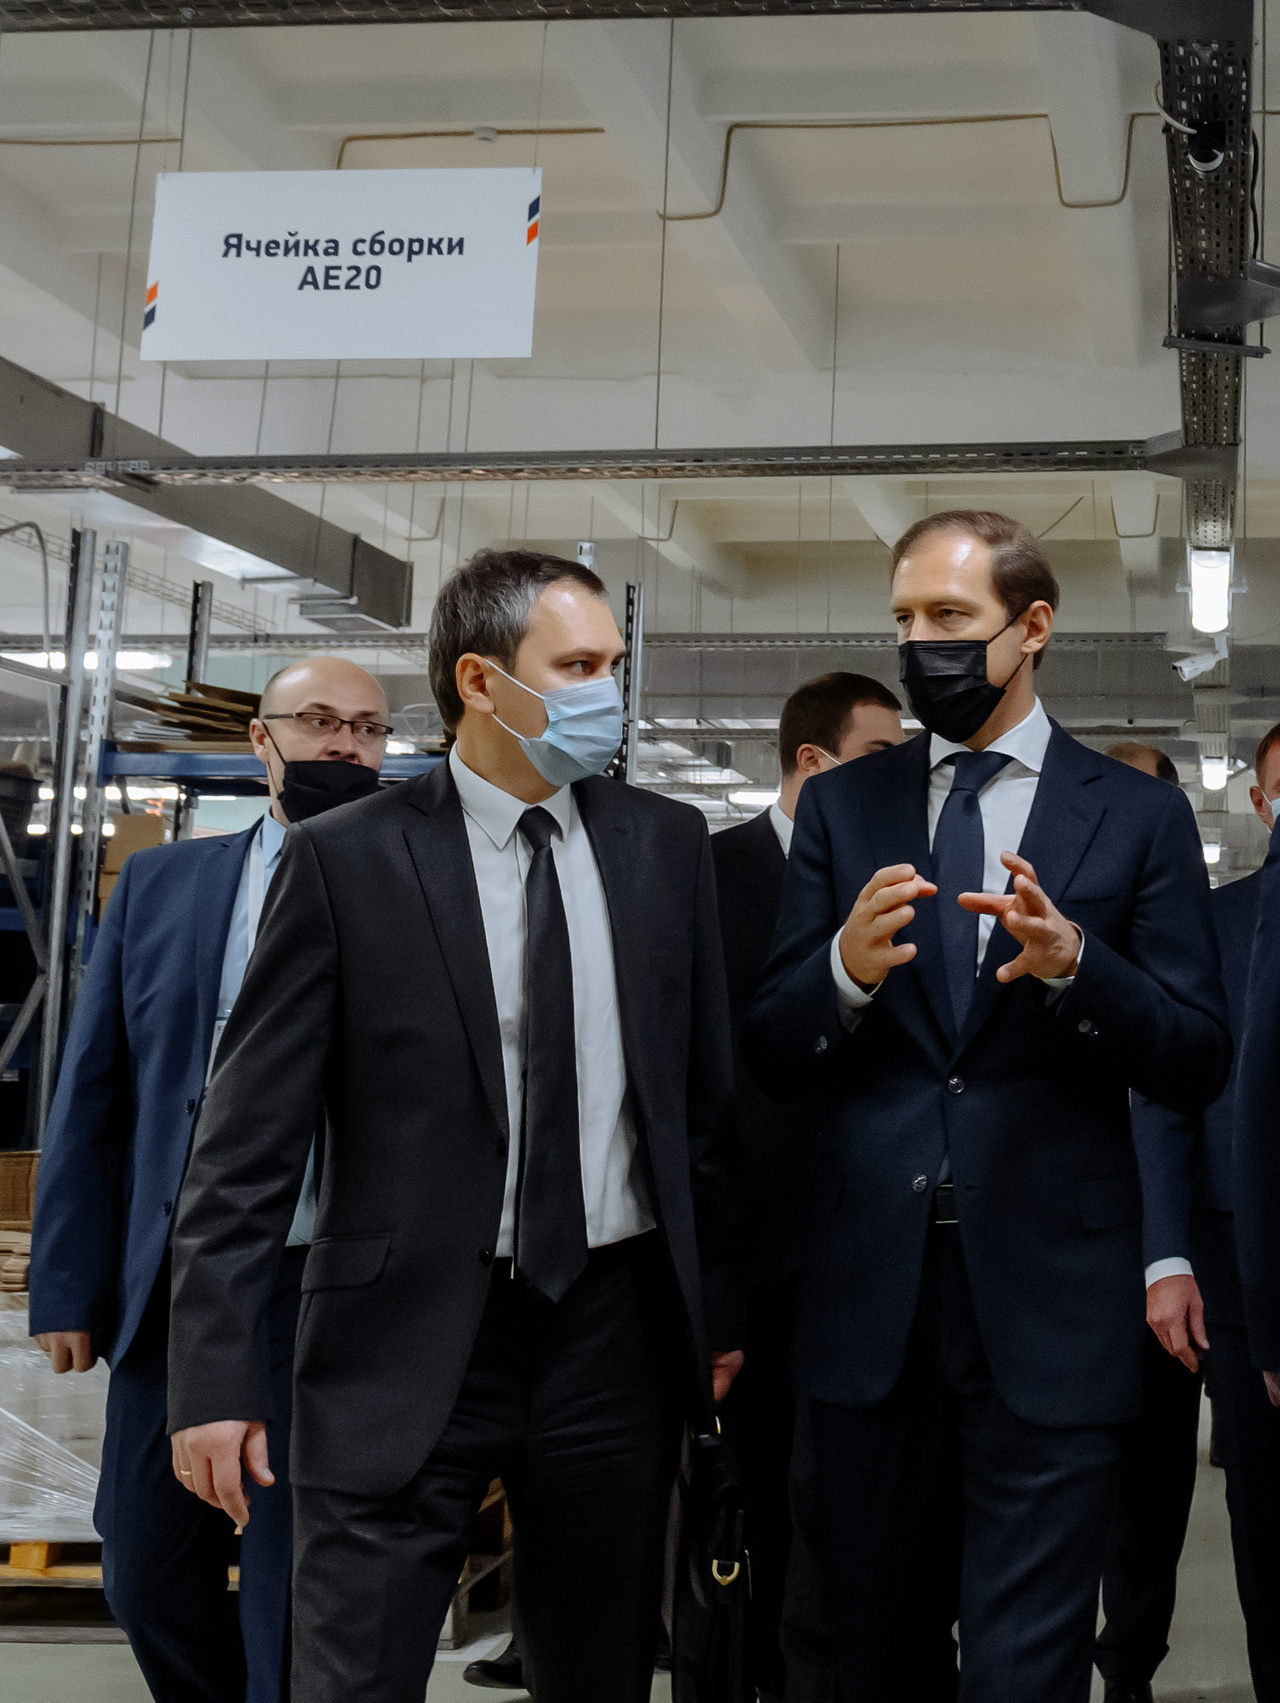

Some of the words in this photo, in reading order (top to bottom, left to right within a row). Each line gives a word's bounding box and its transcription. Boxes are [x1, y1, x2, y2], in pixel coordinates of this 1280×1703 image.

[222, 231, 339, 258] Ячейка
[352, 230, 465, 263] сборки
[297, 265, 382, 291] АЕ20
